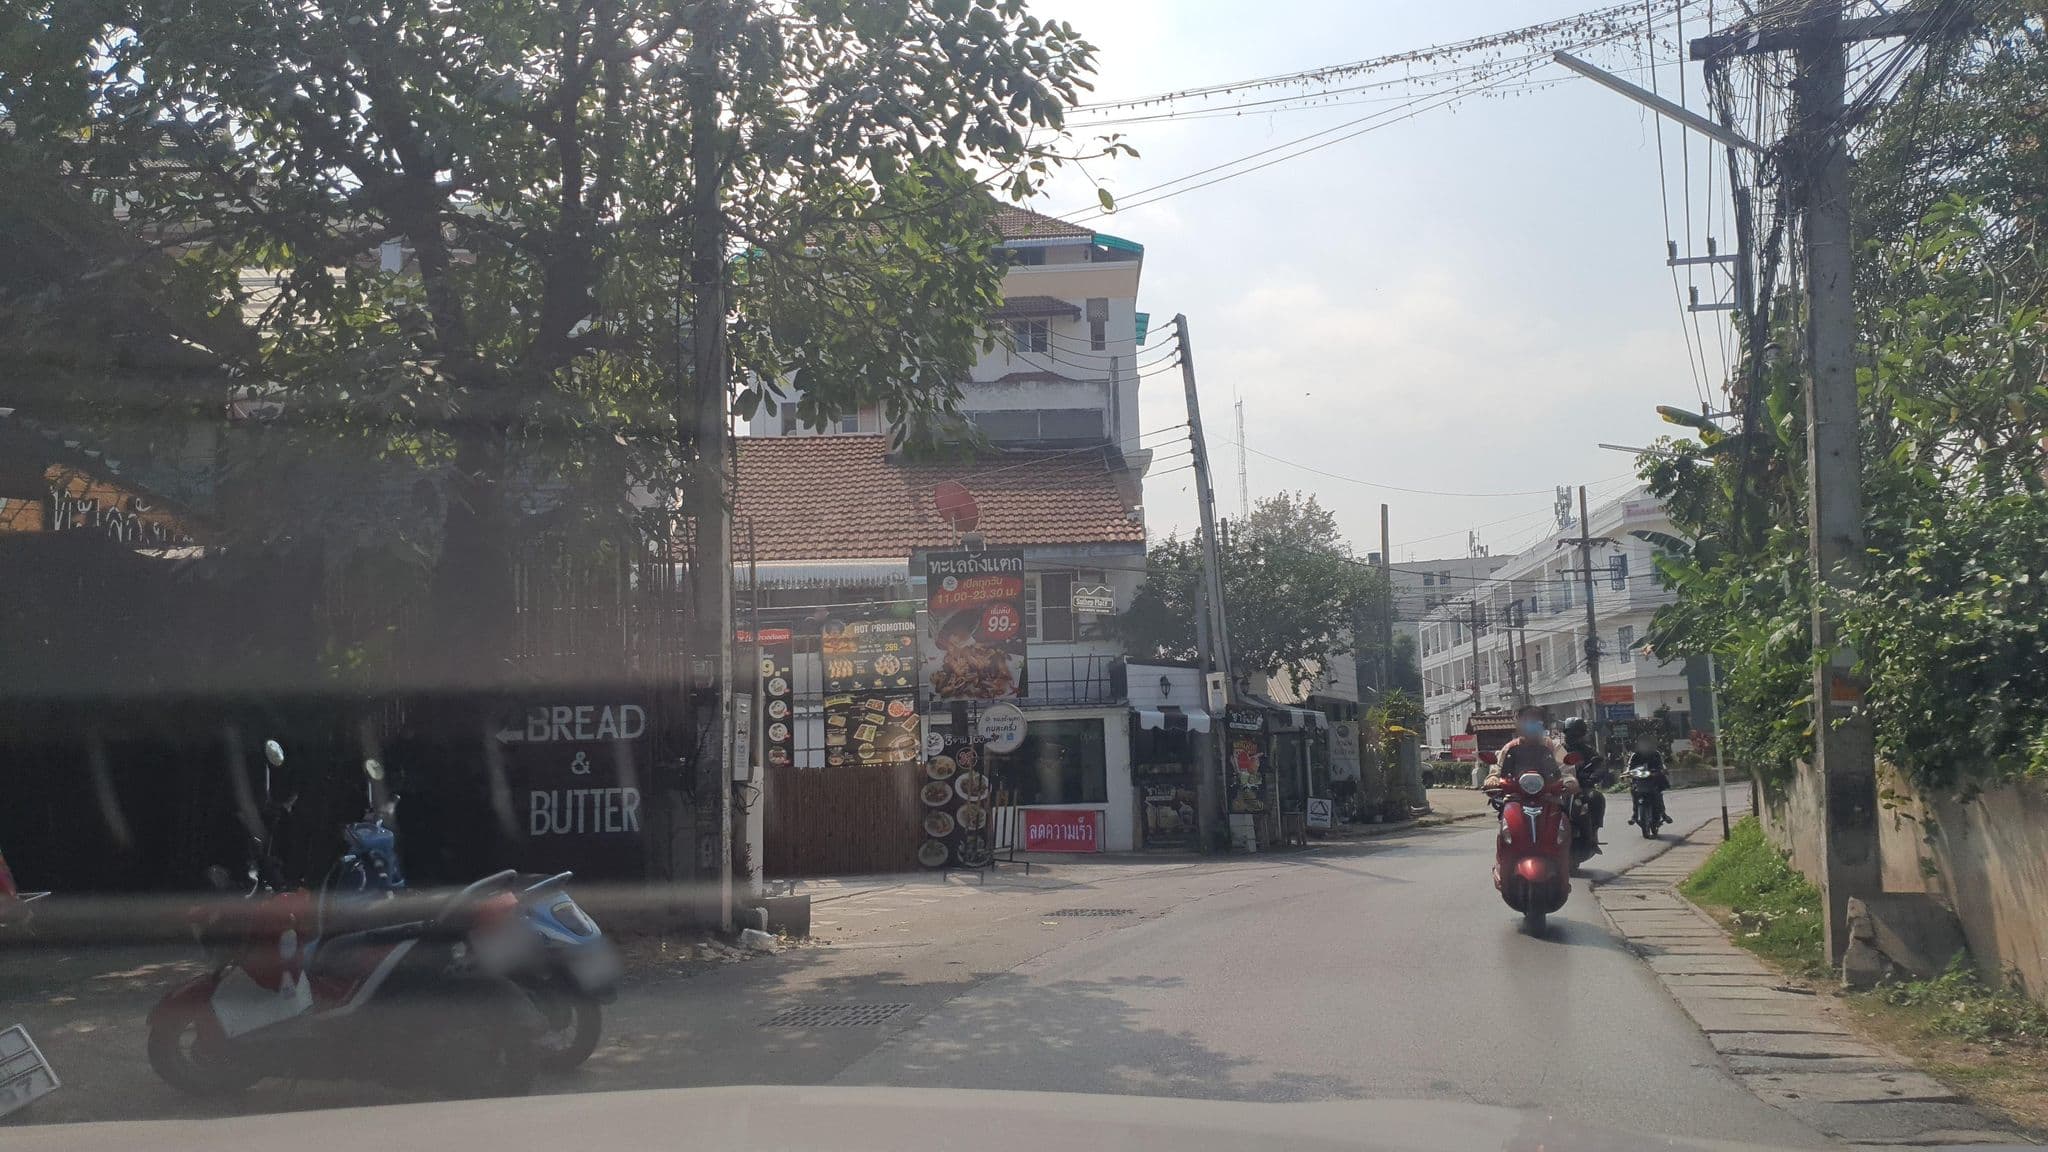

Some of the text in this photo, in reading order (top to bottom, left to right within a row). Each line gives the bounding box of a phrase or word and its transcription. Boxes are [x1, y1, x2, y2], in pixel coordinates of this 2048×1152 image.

[929, 553, 1022, 574] ทะเลถังแตก
[854, 621, 916, 634] HOT PROMOTION
[988, 616, 1017, 632] 99.-
[528, 704, 646, 742] BREAD
[571, 751, 591, 775] &
[530, 786, 641, 836] BUTTER
[1029, 816, 1092, 841] ลดความเร็ว
